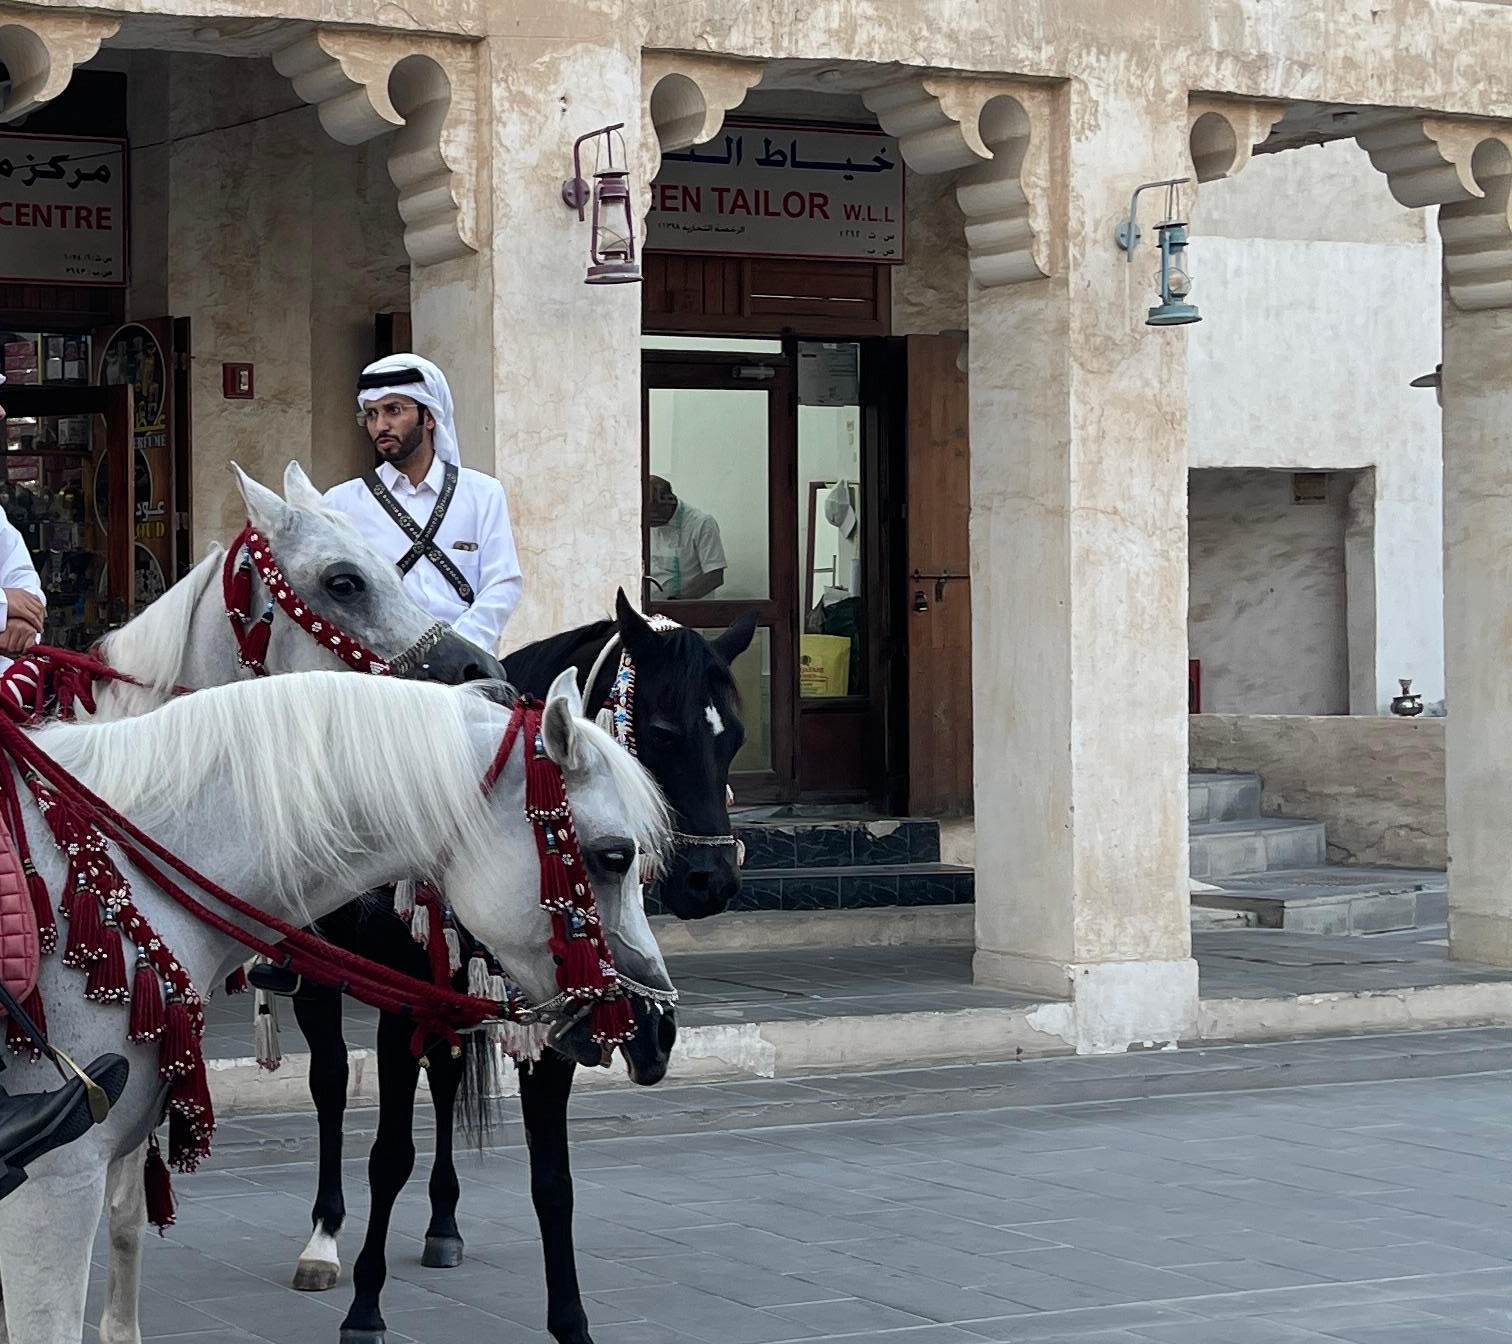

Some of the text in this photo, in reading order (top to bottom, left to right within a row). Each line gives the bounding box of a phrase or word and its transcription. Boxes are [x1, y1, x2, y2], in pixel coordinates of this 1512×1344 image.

[21, 154, 112, 189] مركز
[754, 137, 895, 181] خياط
[711, 186, 830, 220] TAILOR
